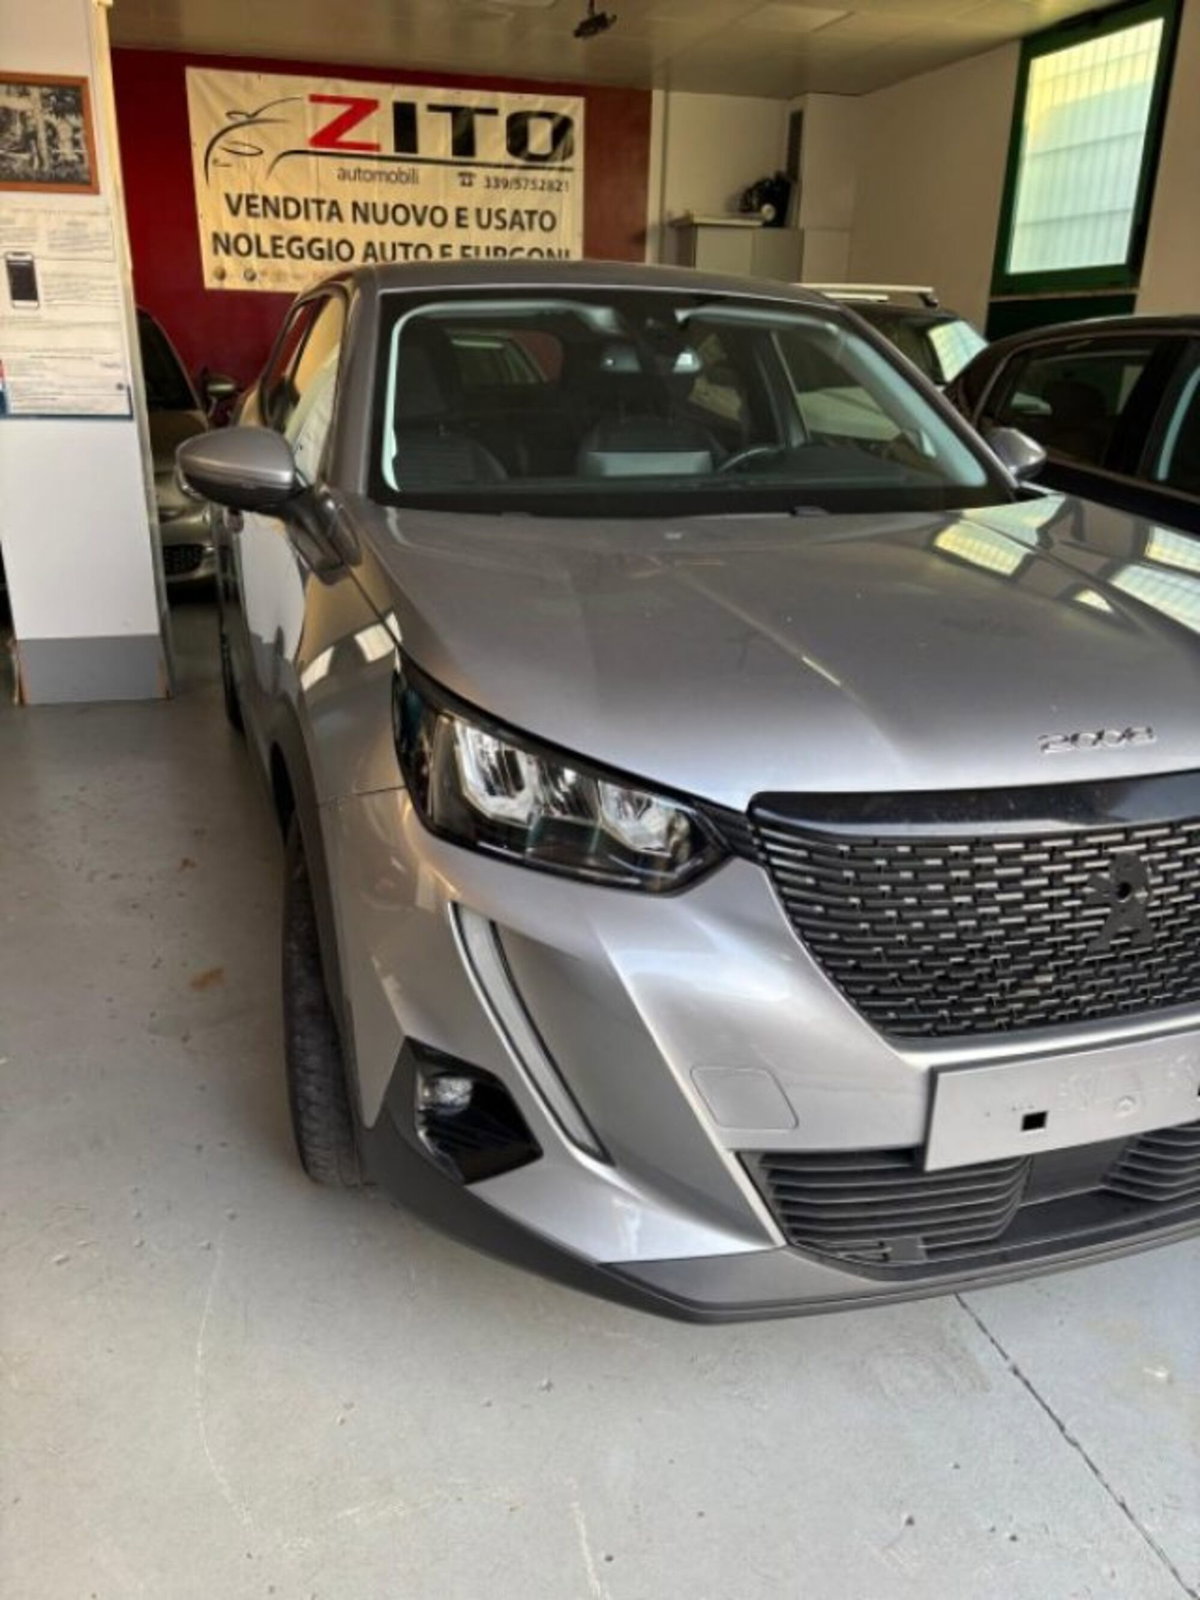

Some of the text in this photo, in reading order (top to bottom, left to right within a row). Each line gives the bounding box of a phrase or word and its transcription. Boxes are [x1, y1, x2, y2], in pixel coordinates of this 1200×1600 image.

[308, 93, 574, 163] ZITO
[336, 166, 420, 185] automobili
[224, 192, 557, 232] VENDITA NUOVO E USATO
[211, 232, 354, 262] NOLEGGIO
[362, 241, 433, 263] AUTO
[1037, 726, 1157, 755] 2008
